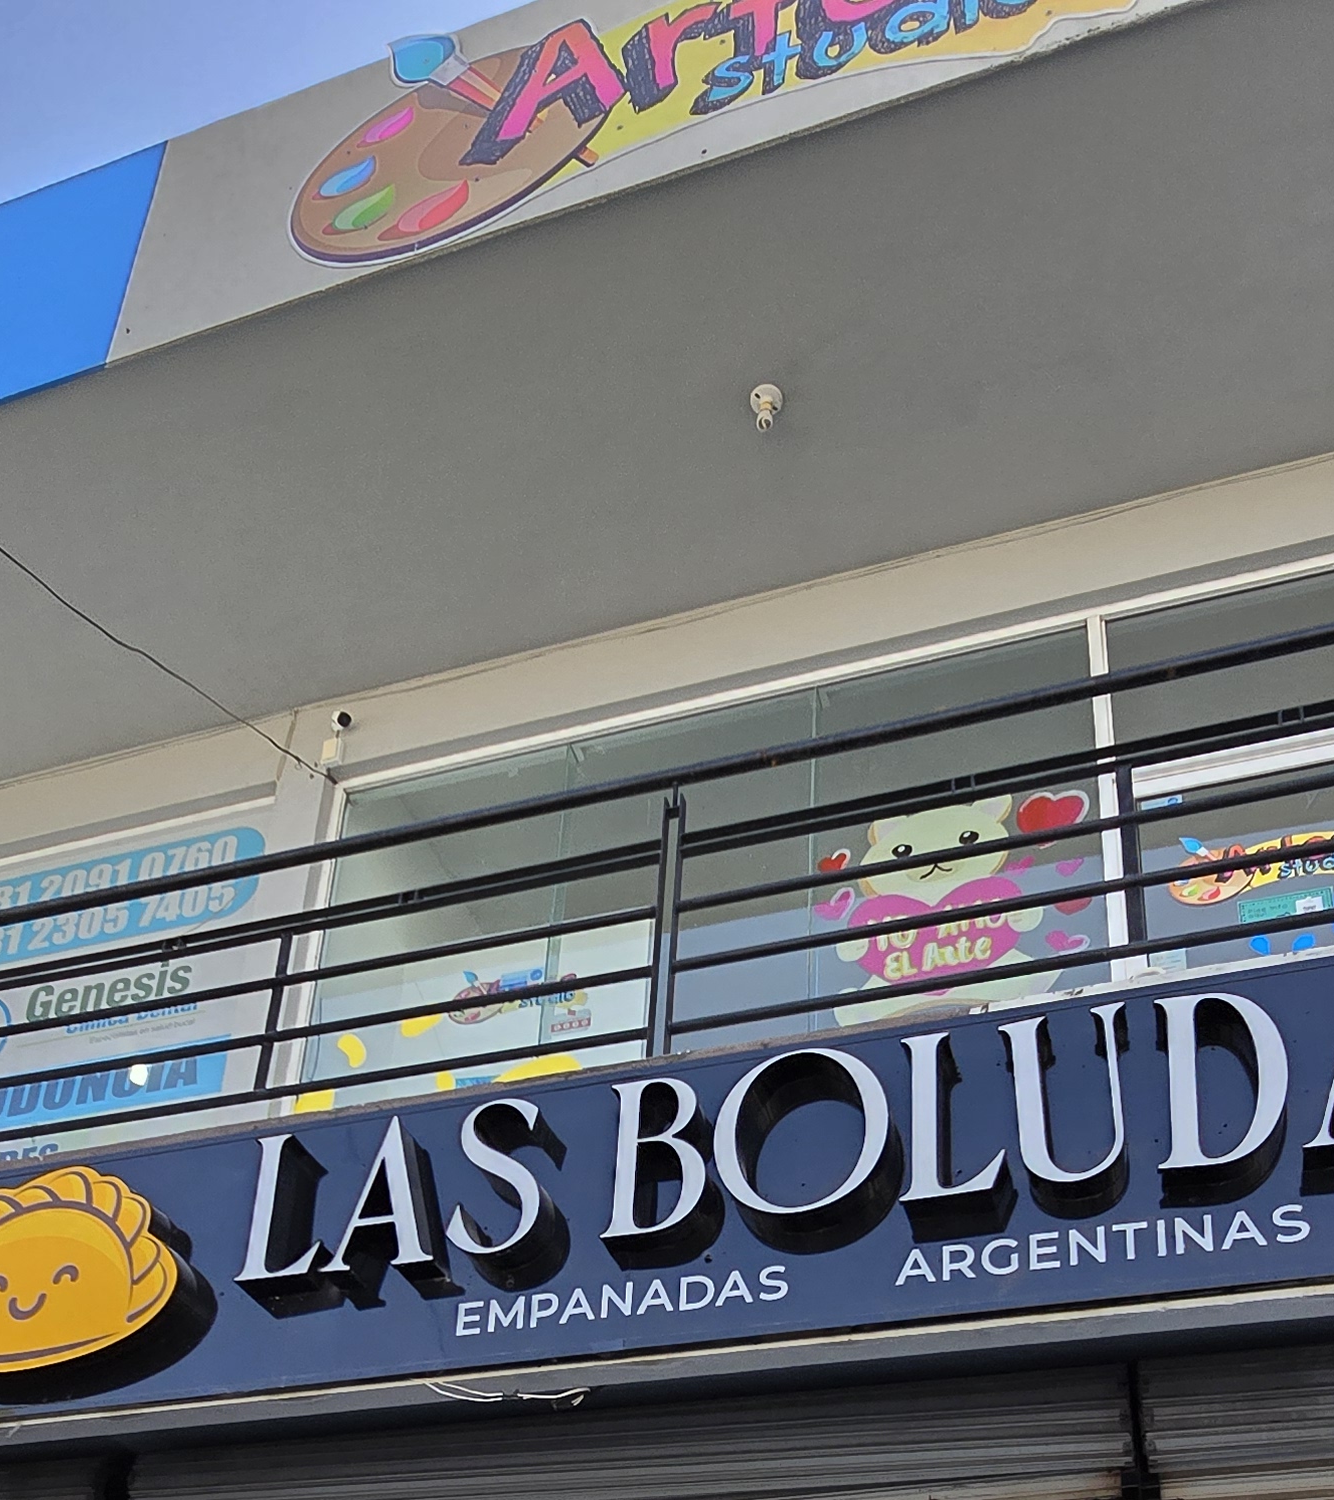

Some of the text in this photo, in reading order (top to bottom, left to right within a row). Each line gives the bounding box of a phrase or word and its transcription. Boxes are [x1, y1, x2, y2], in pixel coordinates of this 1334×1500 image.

[27, 901, 130, 950] 2305
[25, 963, 193, 1023] Genesis
[883, 952, 917, 981] EL
[234, 1097, 541, 1283] LAS
[455, 1203, 1312, 1337] EMPANADAS ARGENTINAS
